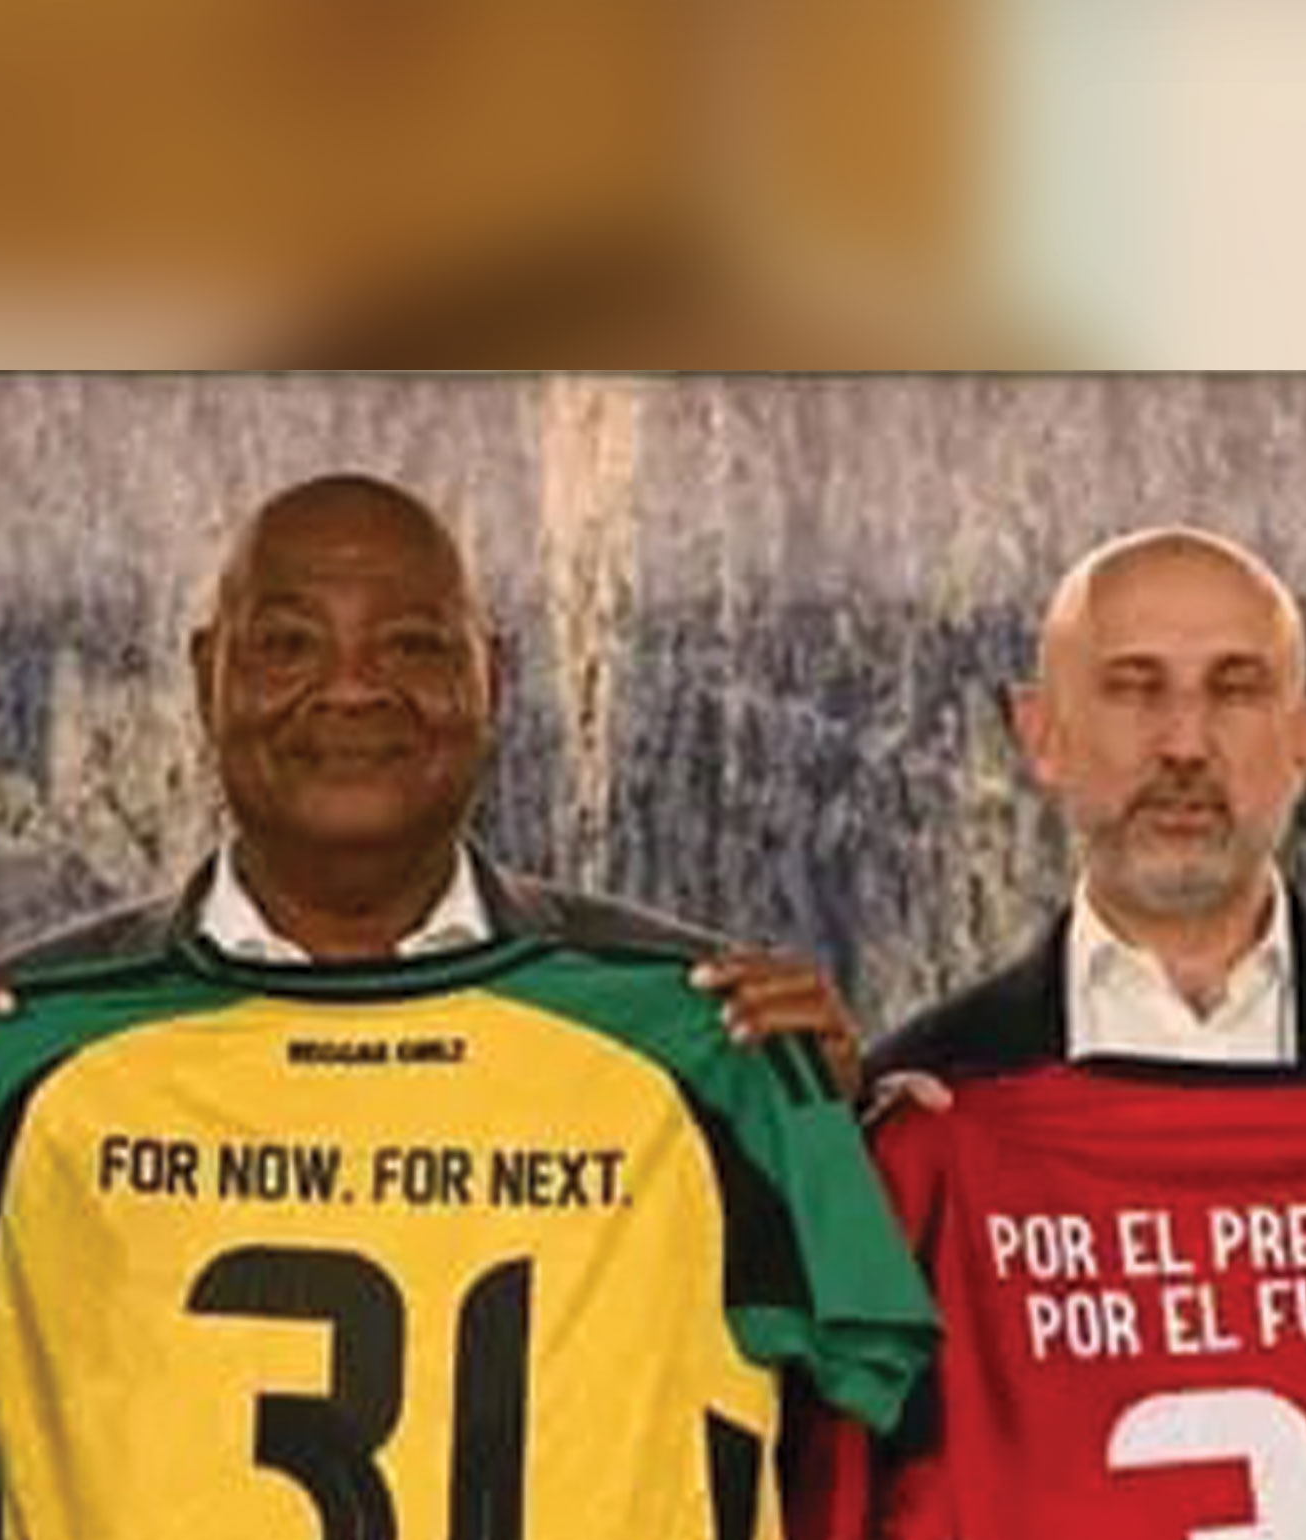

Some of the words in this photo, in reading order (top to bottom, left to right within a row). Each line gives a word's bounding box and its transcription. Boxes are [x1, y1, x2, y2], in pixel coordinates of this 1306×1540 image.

[99, 1137, 198, 1197] FOR
[218, 1146, 353, 1203] NOW.
[373, 1148, 471, 1204] FOR
[492, 1151, 632, 1207] NEXT.
[988, 1214, 1097, 1278] POR
[1117, 1211, 1194, 1276] EL
[1026, 1295, 1141, 1360] POR
[1161, 1285, 1241, 1354] EL
